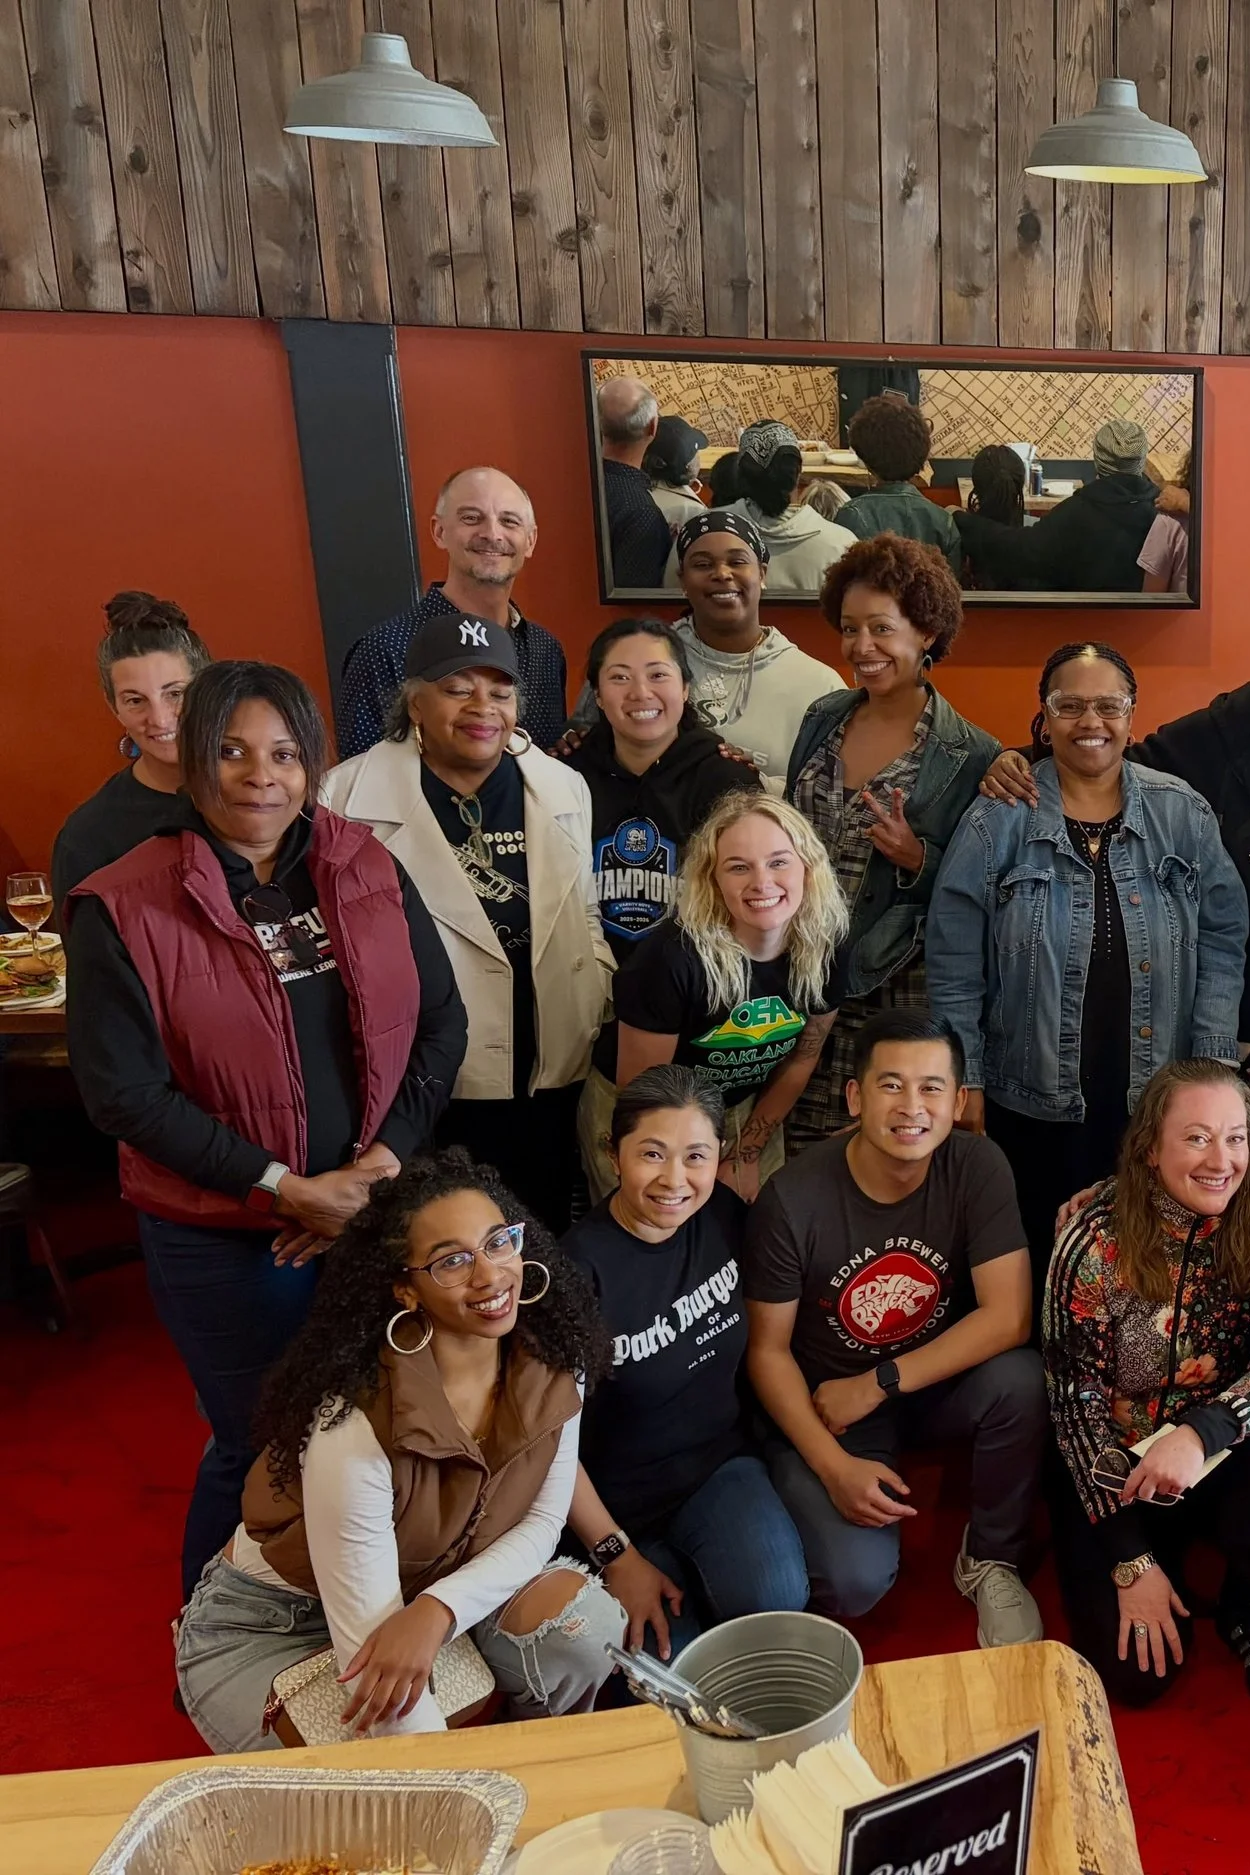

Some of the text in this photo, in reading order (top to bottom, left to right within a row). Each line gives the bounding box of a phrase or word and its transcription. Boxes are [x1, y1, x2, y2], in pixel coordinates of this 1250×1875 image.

[594, 868, 683, 905] HAMPION
[730, 996, 794, 1029] OEA
[708, 1038, 797, 1066] OAKLAND
[695, 1060, 783, 1082] EDUCAT
[830, 1237, 949, 1288] EDNA BREWER
[611, 1258, 739, 1366] Park Burger
[707, 1312, 721, 1325] OF
[695, 1313, 740, 1345] OAKLAND
[699, 1350, 716, 1363] 2012
